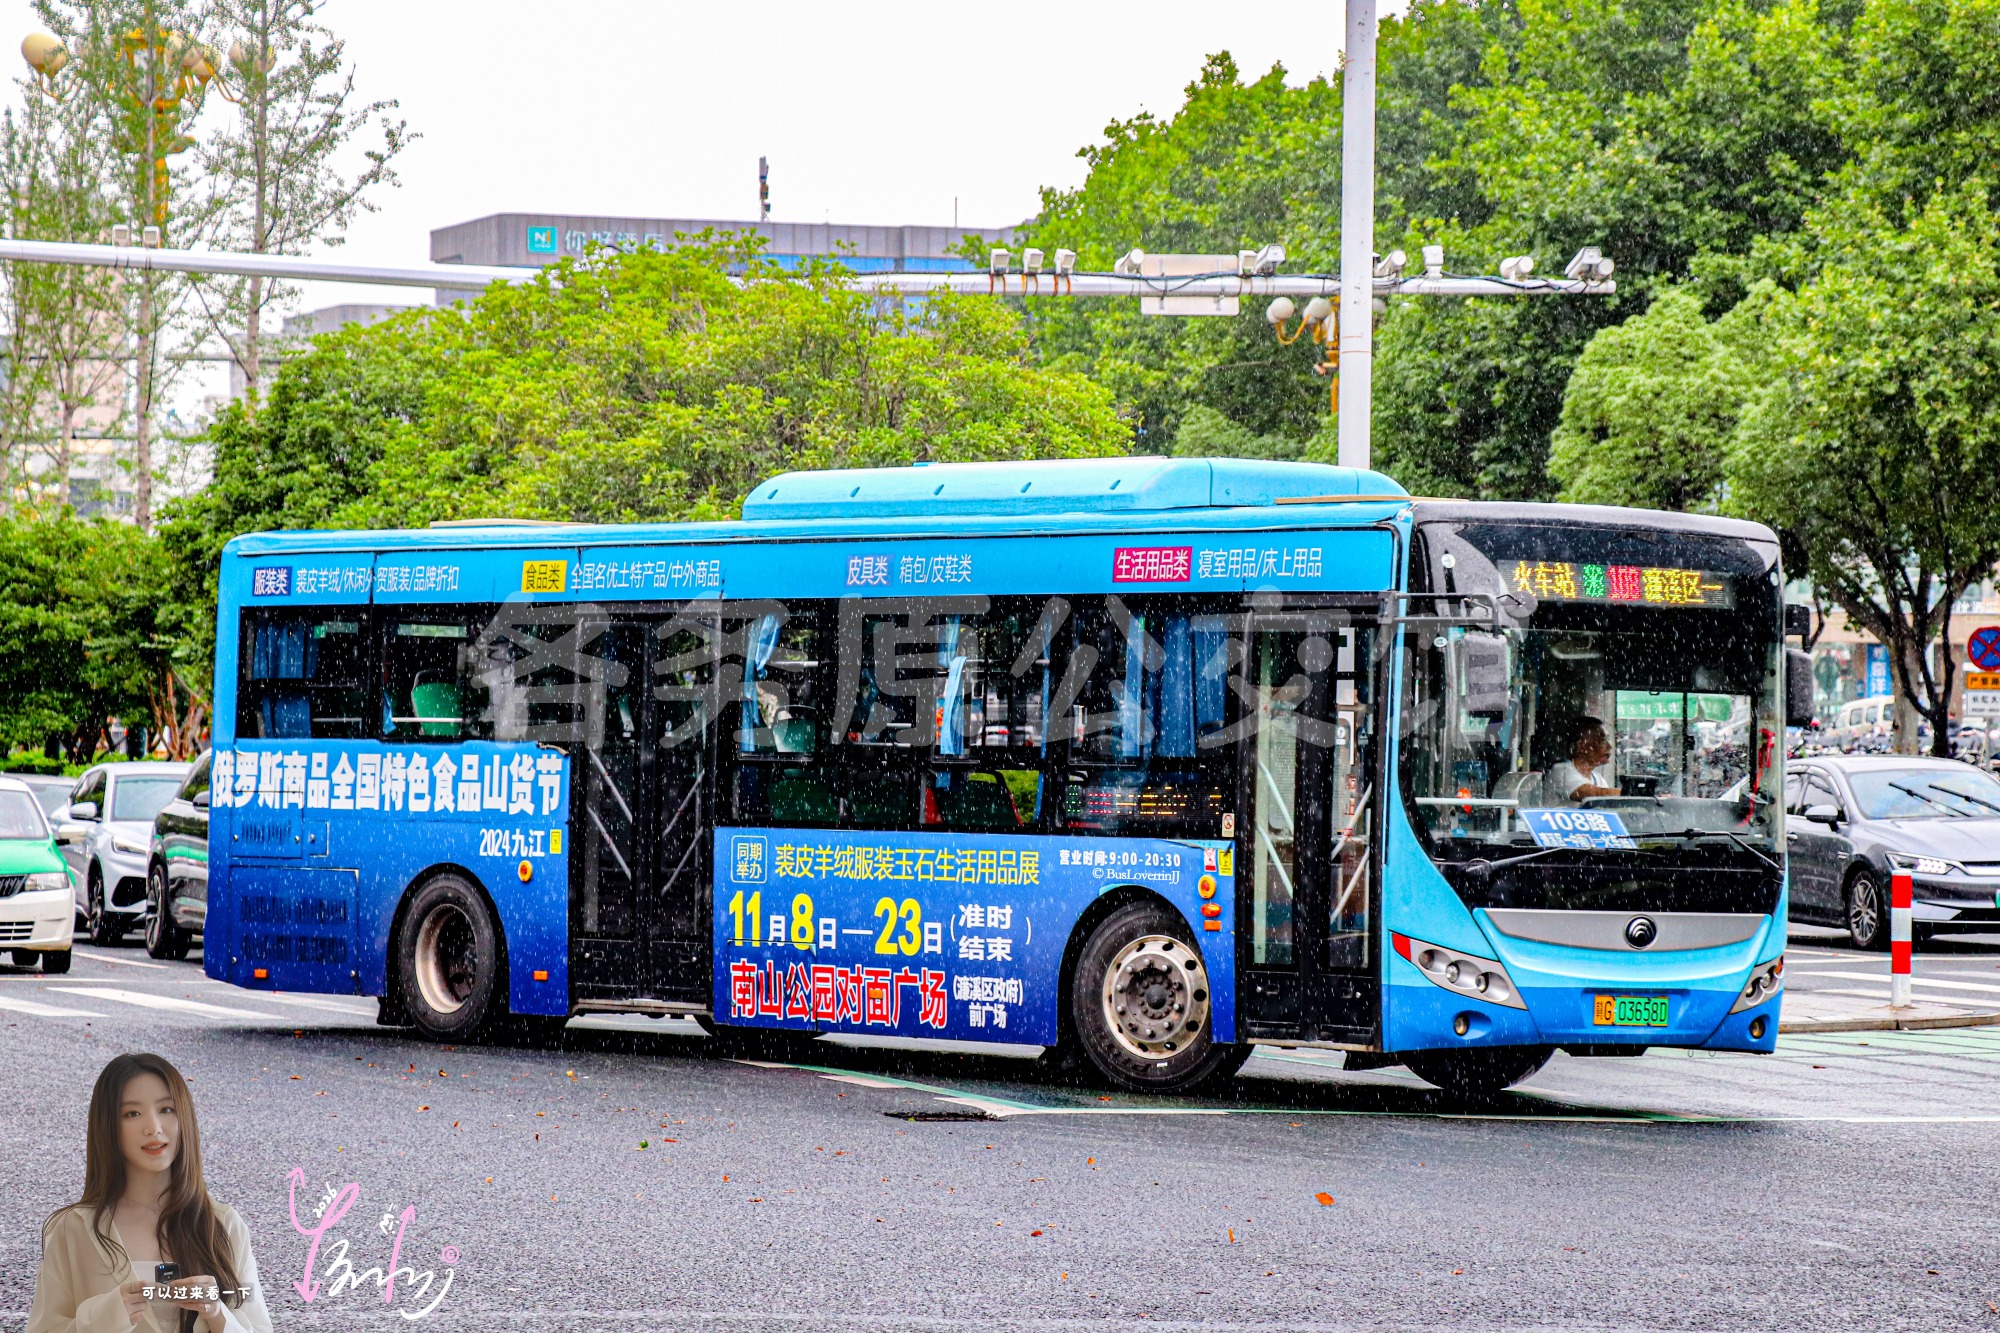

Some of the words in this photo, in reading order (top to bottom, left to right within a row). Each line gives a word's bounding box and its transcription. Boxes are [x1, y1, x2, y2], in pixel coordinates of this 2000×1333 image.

[524, 563, 560, 590] 食品类
[570, 560, 721, 590] 全国名优土特产品/中外商品
[846, 555, 888, 586] 皮具类
[899, 554, 972, 584] 箱包/皮鞋类
[1115, 549, 1189, 580] 生活用品类
[1198, 547, 1323, 578] 寝室用品/床上用品
[253, 568, 288, 595] 服装类
[1513, 560, 1577, 599] 火车站
[211, 750, 562, 815] 俄罗斯商品全国特色食品山货节
[1541, 812, 1613, 833] 108路
[479, 828, 545, 858] 2024九江
[737, 842, 763, 861] 同期
[736, 861, 763, 880] 举办
[774, 844, 1040, 886] 裘皮羊绒服装玉石生活用品展
[730, 958, 948, 1031] 南山公园对面广场
[968, 1001, 1008, 1029] 前广场
